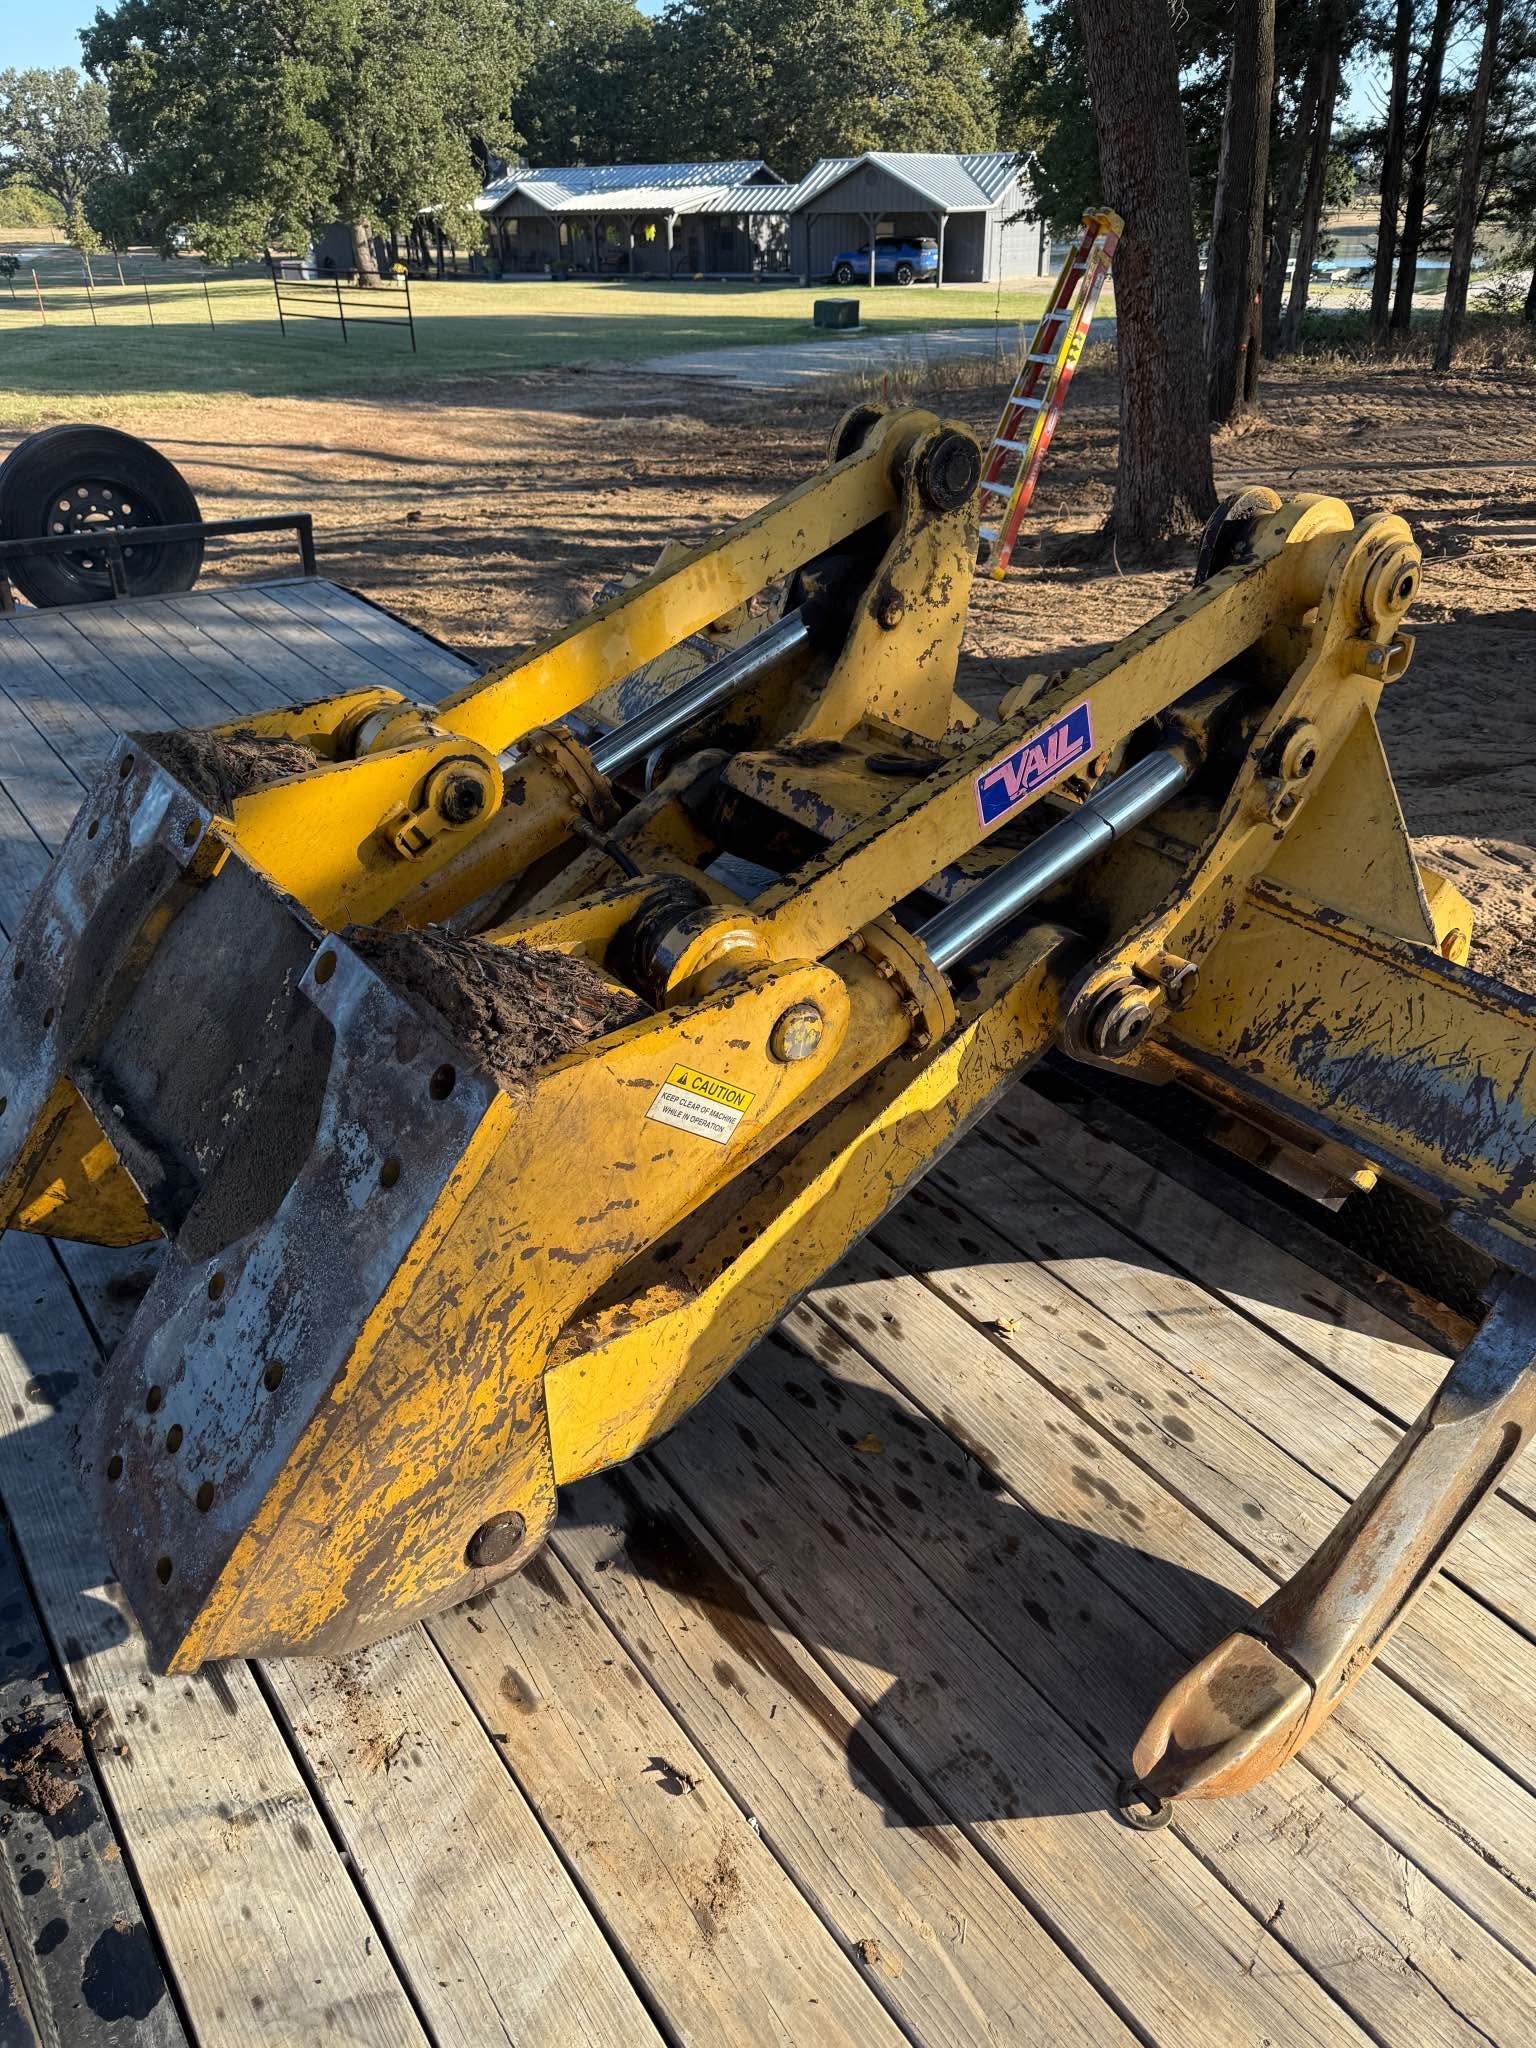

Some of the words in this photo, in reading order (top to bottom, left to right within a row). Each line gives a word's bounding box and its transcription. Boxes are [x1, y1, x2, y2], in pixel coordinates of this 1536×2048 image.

[983, 724, 1084, 801] VAIL
[691, 1077, 745, 1106] CAUTION
[661, 1091, 680, 1103] KEEP
[679, 1098, 701, 1111] CLEAR
[700, 1106, 711, 1114] OF
[708, 1109, 738, 1125] MACHINE
[662, 1105, 684, 1118] WHILE
[682, 1112, 691, 1121] IN
[689, 1115, 725, 1133] OPERATION
